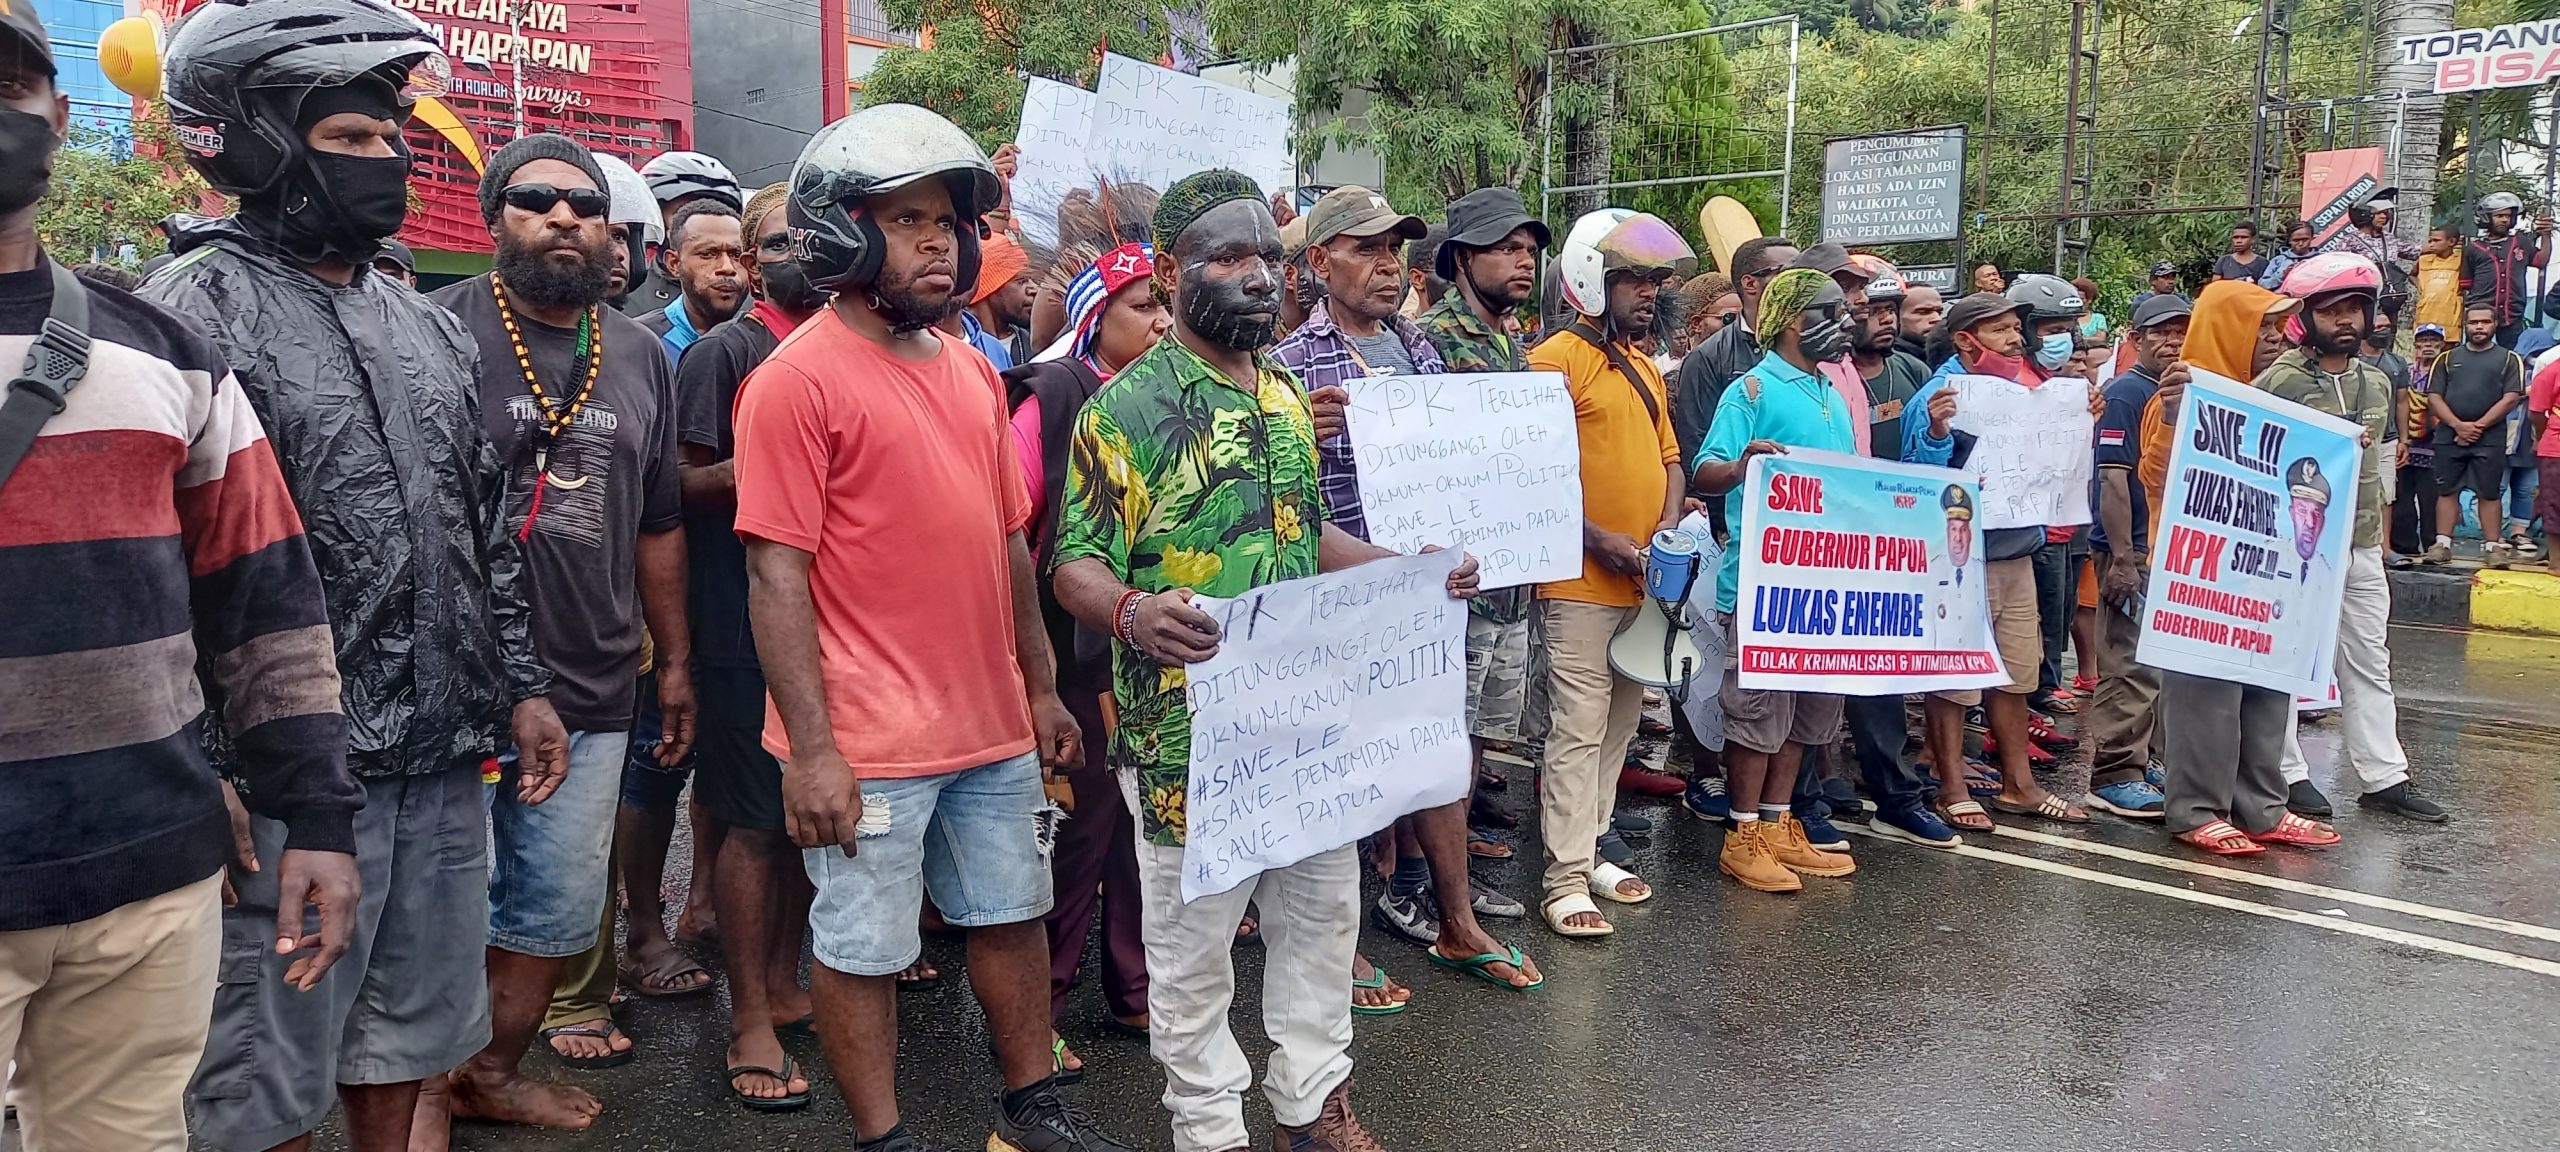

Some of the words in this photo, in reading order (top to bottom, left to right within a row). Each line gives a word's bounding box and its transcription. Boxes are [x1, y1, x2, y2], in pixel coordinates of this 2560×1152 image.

[448, 26, 592, 74] HARAPAN
[466, 78, 508, 99] ADALAH
[1106, 58, 1180, 105] KPK
[1825, 169, 1873, 184] LOKASI
[1875, 162, 1923, 179] TAMAN
[1926, 159, 1957, 174] IMBI
[1850, 146, 1940, 167] PENGGUNAAN
[1836, 196, 1908, 212] WALIKOTA
[1837, 182, 1882, 196] HARUS
[1886, 179, 1913, 193] ADA
[1918, 176, 1947, 191] IZIN
[1825, 226, 1851, 240] DAN
[1857, 220, 1951, 238] PERTAMANAN
[1832, 211, 1870, 226] DINAS
[1871, 207, 1944, 223] TATAKOTA
[1902, 268, 1947, 283] APURA
[1346, 378, 1455, 427] KPK
[1467, 378, 1566, 415] TERLIHAT
[1501, 424, 1548, 450] OLEH
[1364, 470, 1490, 511] OKNUM-OKNUM
[1767, 473, 1823, 515] SAVE
[1525, 507, 1571, 532] PAPUA
[1761, 526, 1870, 571] GUBERNUR
[1874, 535, 1928, 574] PAPUA
[2164, 525, 2227, 583] KPK
[1304, 568, 1425, 626] TERLIHAT
[1752, 585, 1838, 636] LUKAS
[1841, 590, 1924, 638] ENEMBE
[2167, 580, 2272, 624] KRIMINALISASI
[2152, 609, 2230, 646] GUBERNUR
[2230, 626, 2273, 656] PAPUA
[1188, 632, 1370, 713] DITUNGGANGI
[1380, 604, 1447, 655] OLEH
[1368, 634, 1460, 696] POLITIK
[1750, 650, 1798, 671] TOLAK
[1802, 652, 1896, 672] KRIMINALISASI
[1900, 656, 1908, 671] &
[1911, 655, 1966, 672] INTIMIDASI
[1966, 655, 1990, 671] KPK
[1409, 721, 1463, 754] PAPUA
